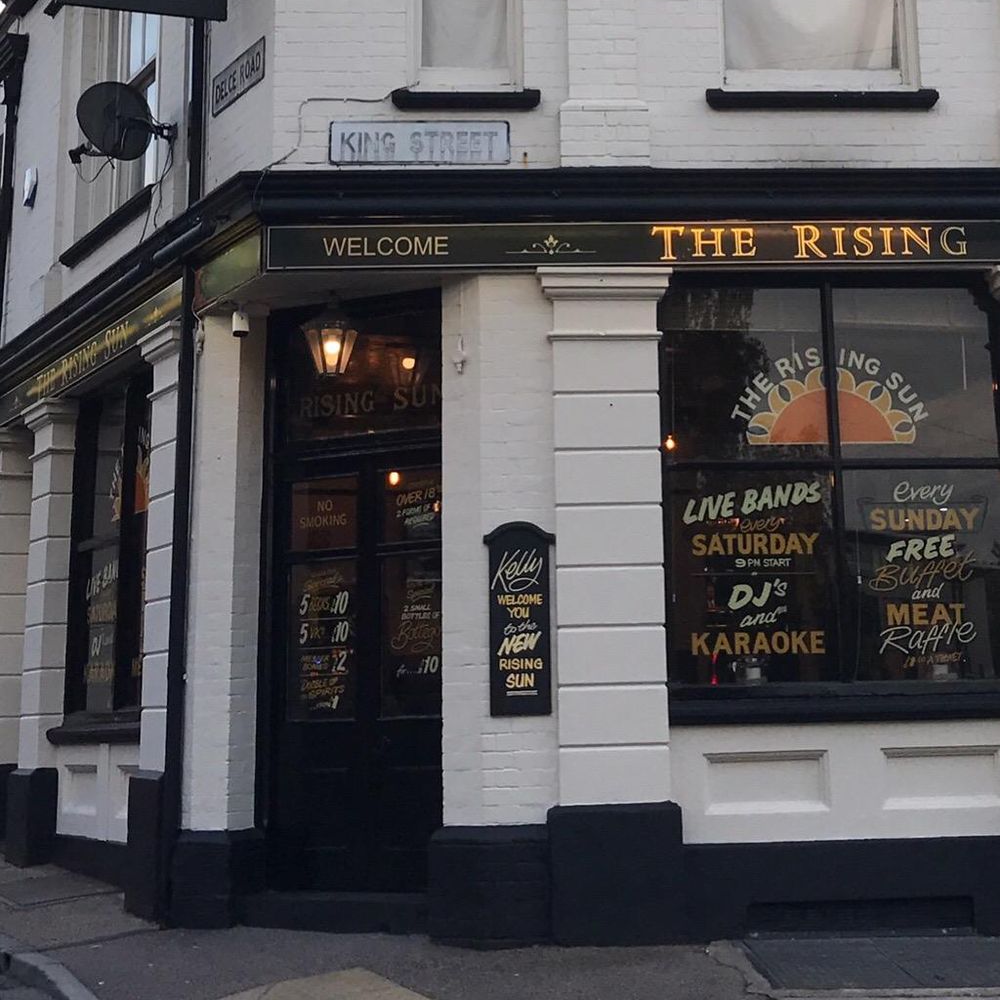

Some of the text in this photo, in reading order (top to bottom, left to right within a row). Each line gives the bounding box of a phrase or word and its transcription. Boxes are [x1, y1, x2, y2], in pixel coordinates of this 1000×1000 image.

[215, 51, 261, 104] DELCE ROAD
[341, 130, 498, 154] KING STREET
[323, 236, 449, 257] WELCOME
[651, 225, 757, 260] THE
[792, 224, 968, 258] RISING
[300, 389, 376, 419] RISING
[731, 371, 775, 422] THE
[885, 371, 929, 423] SUN
[682, 481, 822, 525] LIVE BANDS
[893, 481, 954, 505] every
[317, 499, 333, 512] NO
[299, 512, 348, 529] SMOKING
[739, 517, 781, 533] every
[869, 506, 980, 531] SUNDAY
[691, 532, 820, 556] SATURDAY
[886, 533, 956, 563] FREE
[491, 548, 543, 593] Kelly
[763, 557, 792, 568] START
[868, 550, 977, 592] Buffet
[497, 594, 544, 606] WELCOME
[727, 578, 788, 611] DJ's
[911, 582, 945, 600] and
[299, 593, 311, 615] 5
[506, 607, 530, 619] YOU
[886, 603, 966, 626] MEAT
[518, 619, 538, 632] the
[739, 607, 783, 629] and
[299, 622, 309, 644] 5
[497, 631, 542, 656] NEW
[691, 630, 826, 656] KARAOKE
[879, 621, 977, 655] Raffle
[499, 657, 543, 671] RISING
[505, 672, 535, 688] SUN
